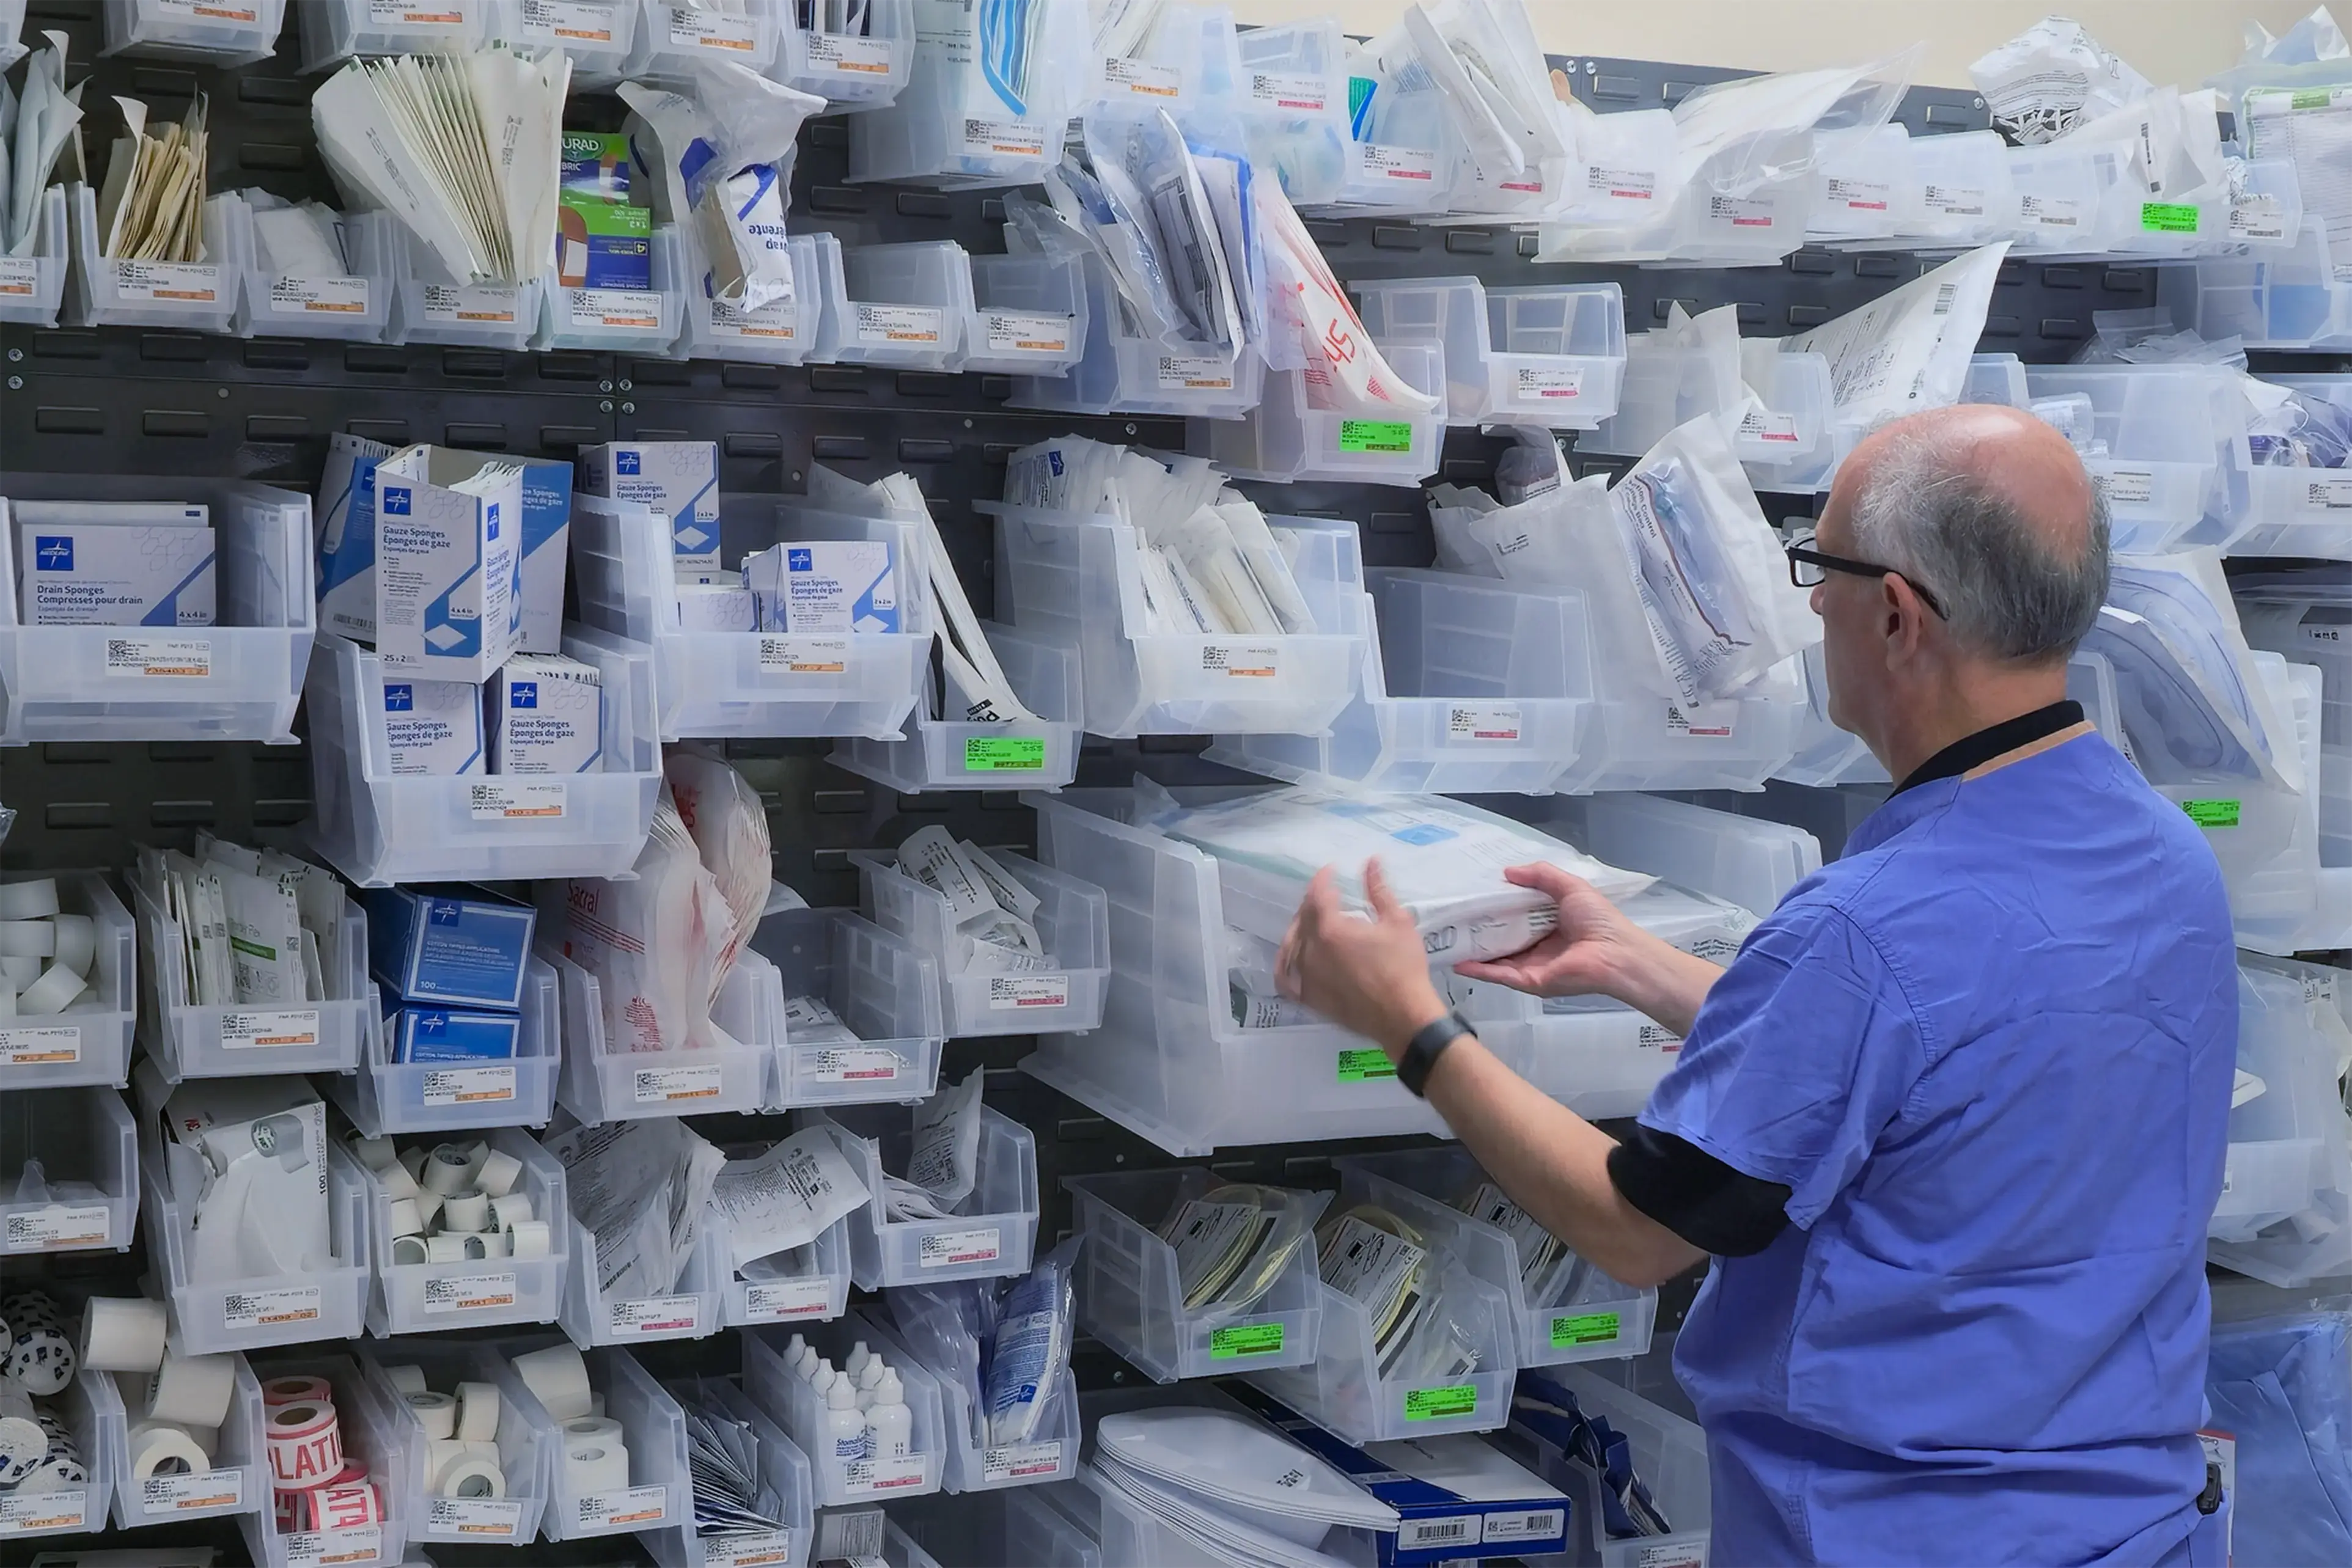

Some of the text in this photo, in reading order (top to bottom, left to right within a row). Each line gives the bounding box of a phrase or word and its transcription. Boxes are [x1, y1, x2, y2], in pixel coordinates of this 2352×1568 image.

[560, 139, 599, 152] URAD
[749, 225, 784, 238] érente
[637, 485, 663, 493] Sponges
[383, 526, 446, 540] Gauze Sponges
[419, 538, 430, 546] de
[430, 541, 451, 549] gaze
[37, 585, 105, 596] Drain Sponges
[37, 595, 144, 606] Compresses pour drain
[413, 722, 447, 731] Sponges
[536, 720, 570, 729] Sponges
[433, 731, 453, 740] gaze
[567, 877, 600, 916] Sacral
[421, 981, 436, 989] 100
